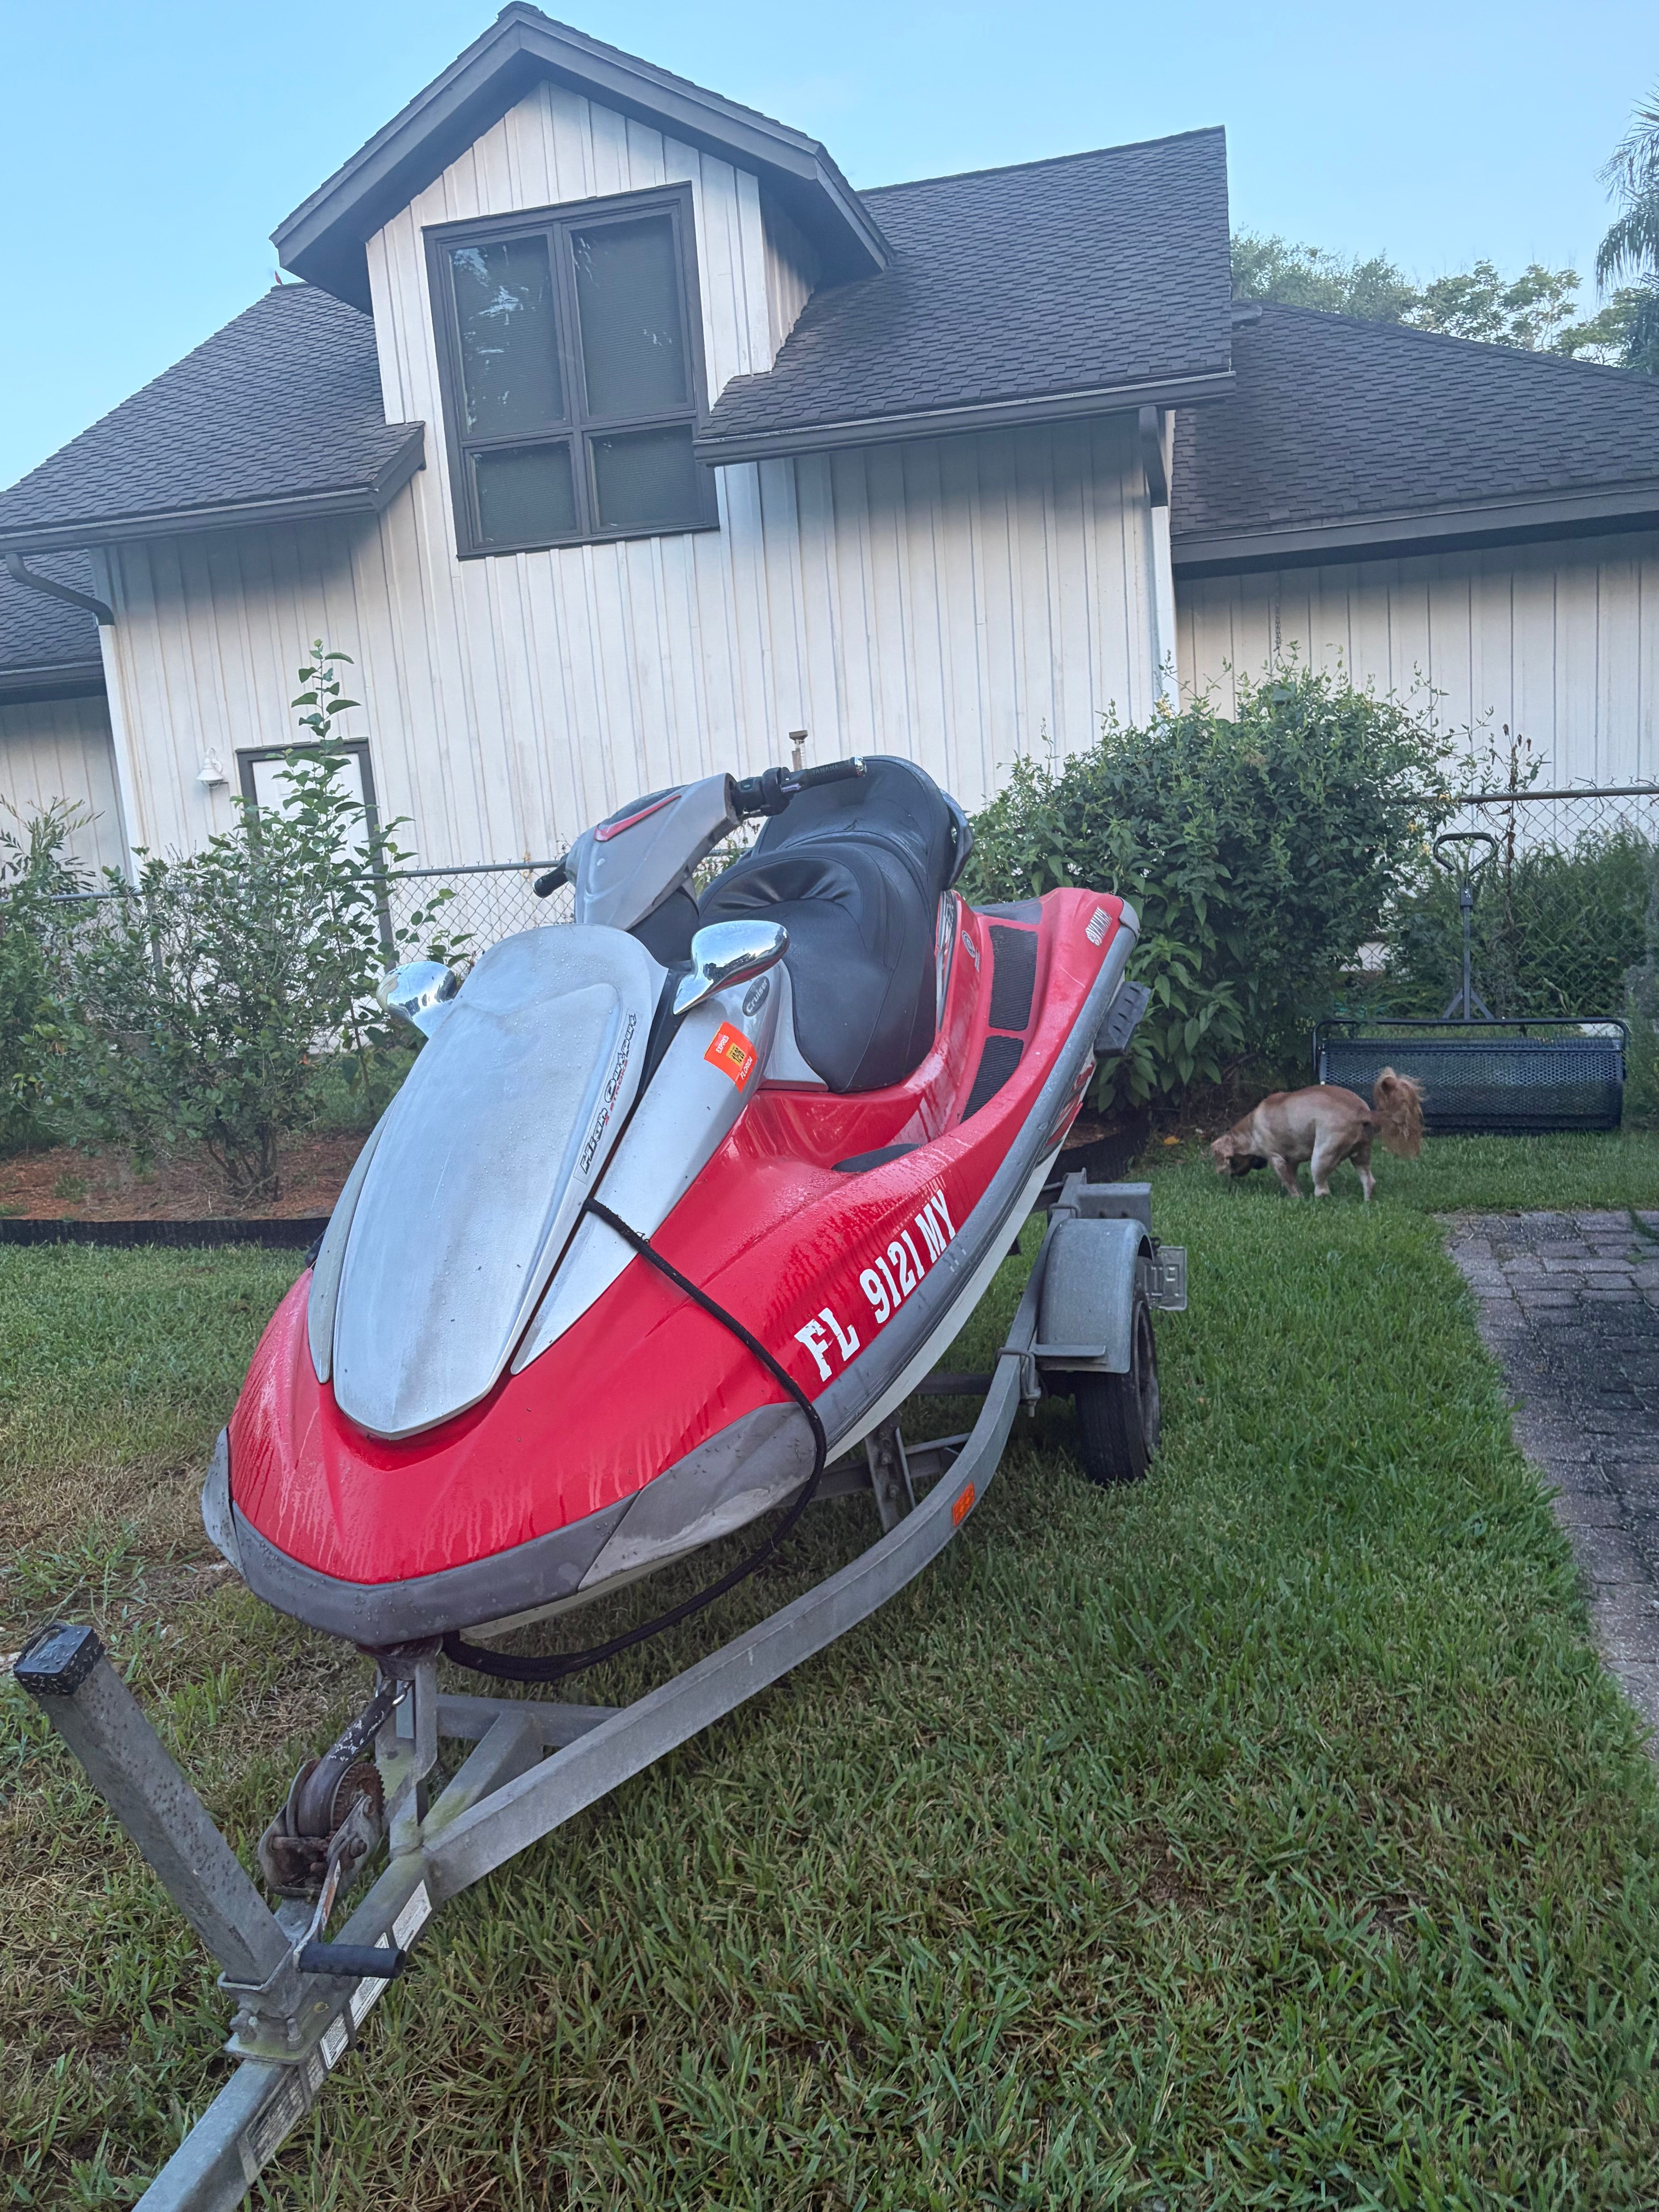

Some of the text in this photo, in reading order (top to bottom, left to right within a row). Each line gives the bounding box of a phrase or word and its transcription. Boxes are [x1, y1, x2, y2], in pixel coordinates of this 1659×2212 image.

[746, 979, 767, 1013] Cruiser
[716, 1035, 729, 1053] EXPIRES
[740, 1056, 753, 1080] FLORIDA
[794, 1189, 956, 1382] FL 9121 MY
